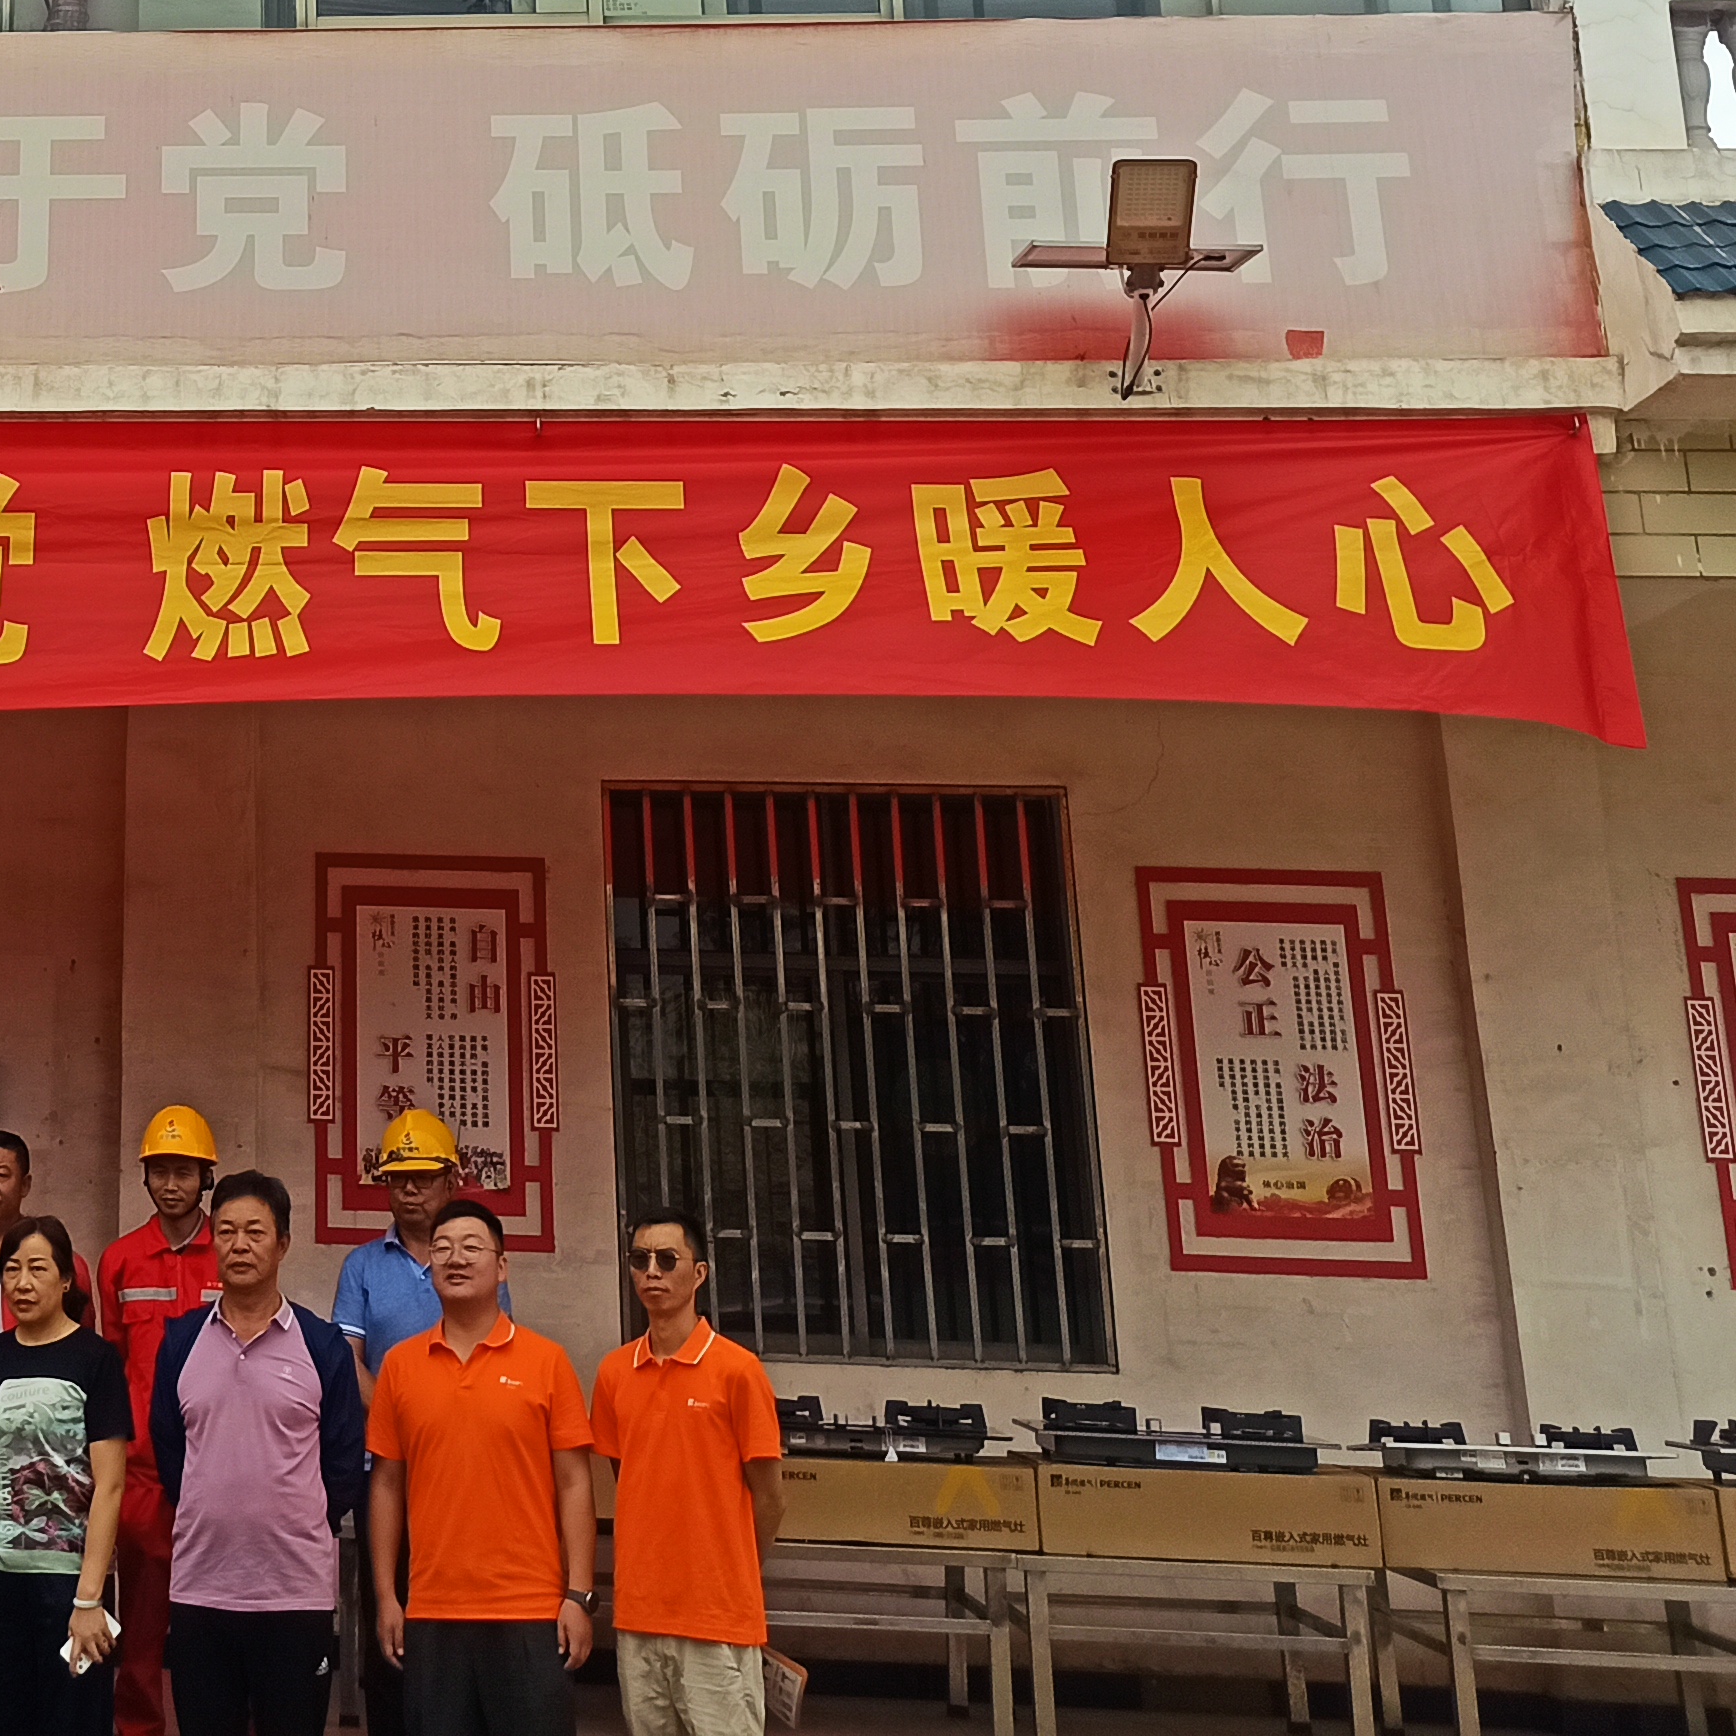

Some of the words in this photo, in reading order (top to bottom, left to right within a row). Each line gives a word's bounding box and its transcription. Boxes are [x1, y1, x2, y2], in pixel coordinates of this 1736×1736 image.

[490, 88, 1410, 289] 砥砺前行
[142, 464, 1514, 661] 燃气下乡暖人心
[469, 923, 502, 1014] 自由
[1232, 947, 1282, 1037] 公正
[376, 1034, 416, 1121] 平等
[1297, 1063, 1345, 1160] 法治
[0, 1385, 51, 1403] couture
[781, 1469, 818, 1481] ERCEN
[1099, 1479, 1142, 1490] PERCEN
[1441, 1493, 1484, 1504] PERCEN
[909, 1515, 1025, 1534] 百尊嵌入式家用燃气灶
[1251, 1528, 1369, 1548] 百尊嵌入式家用燃气灶
[1593, 1548, 1711, 1567] 百尊嵌入式家用燃气灶
